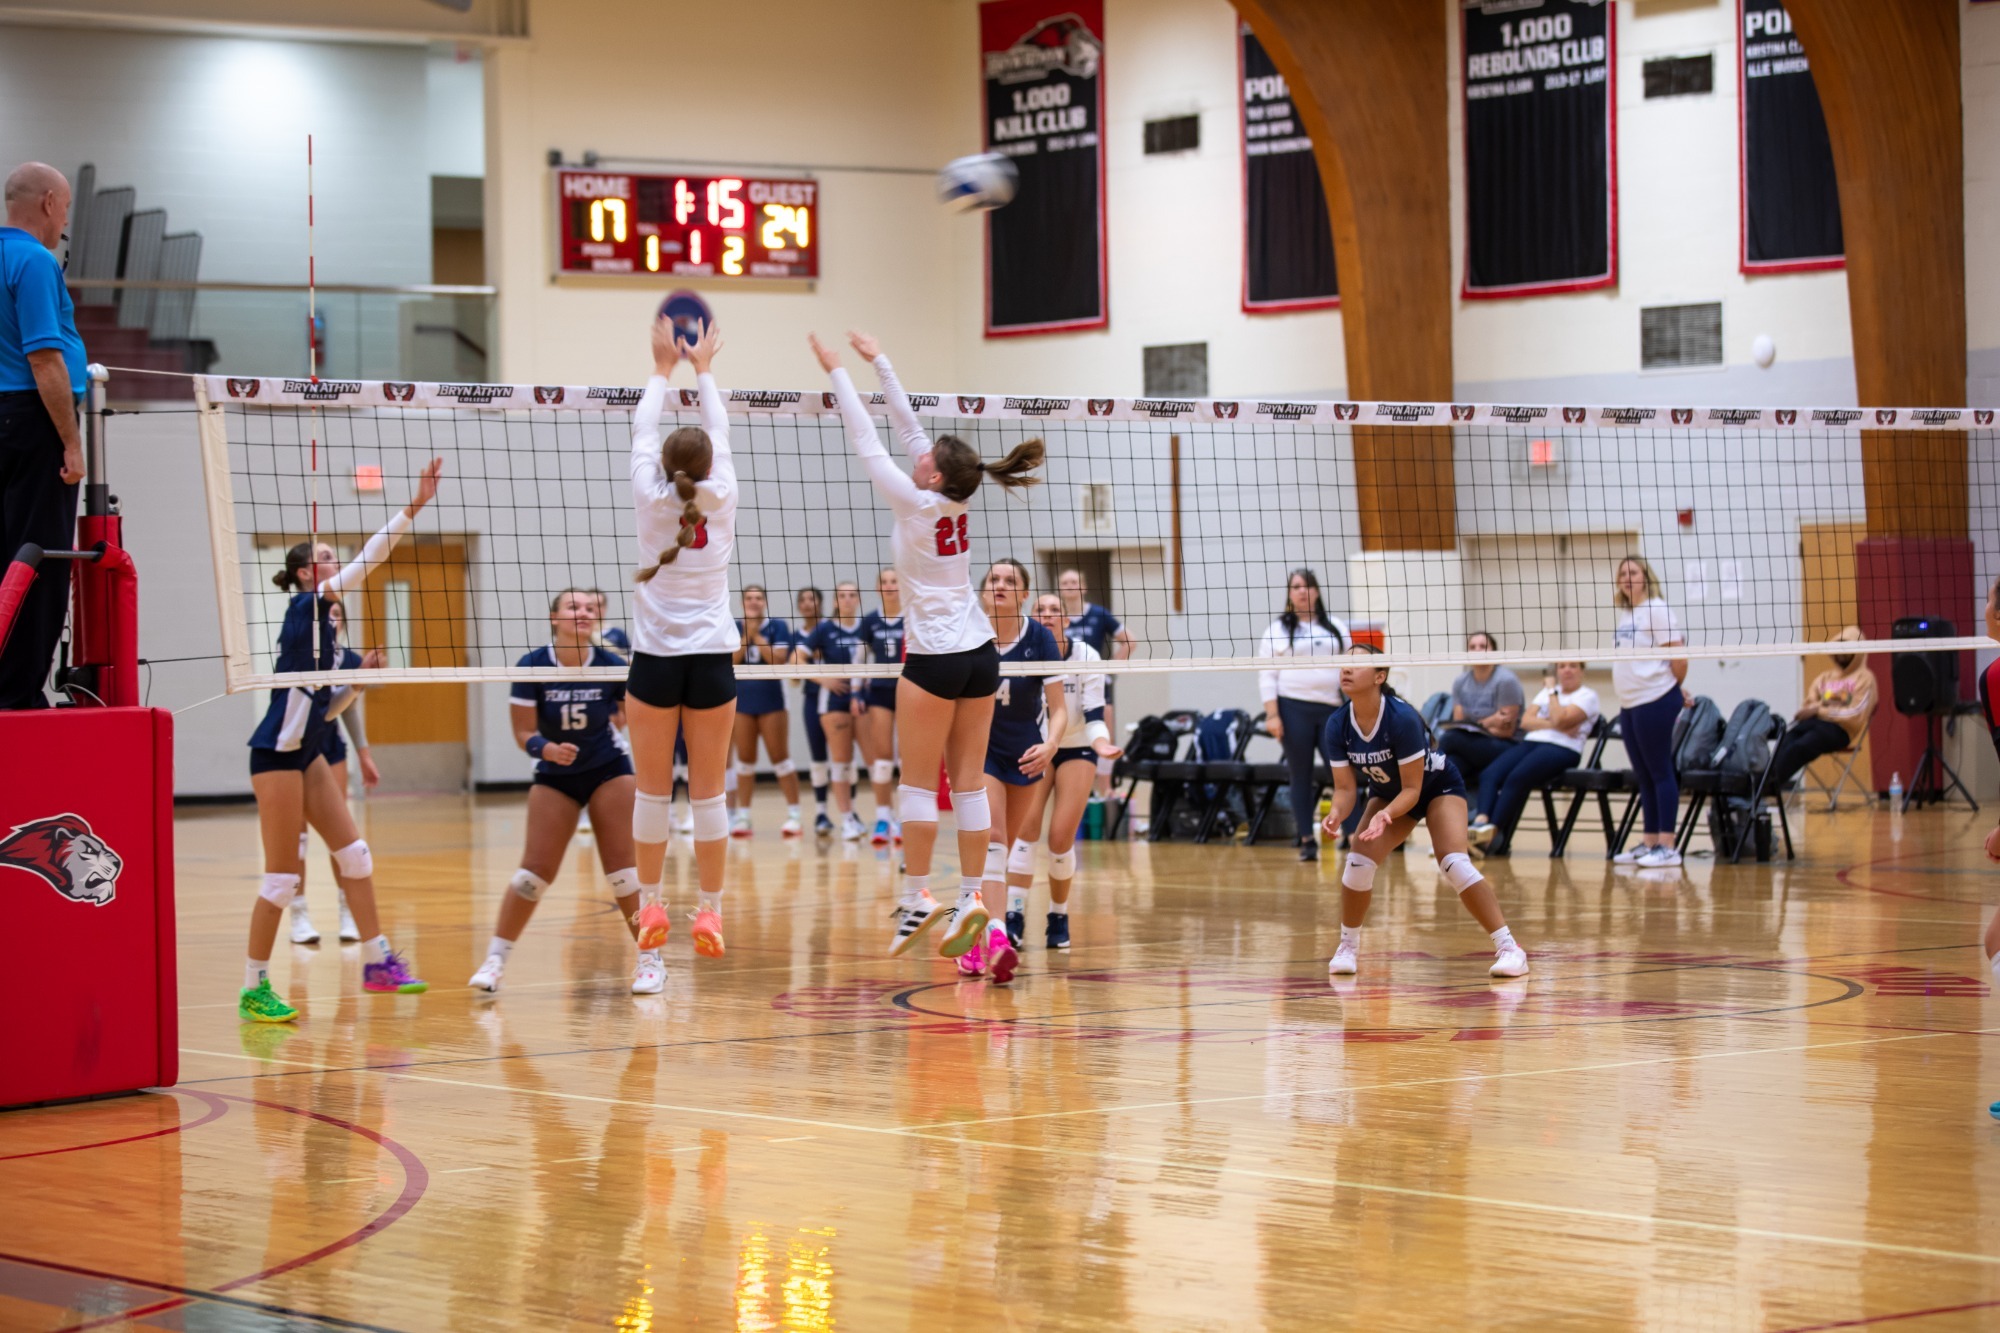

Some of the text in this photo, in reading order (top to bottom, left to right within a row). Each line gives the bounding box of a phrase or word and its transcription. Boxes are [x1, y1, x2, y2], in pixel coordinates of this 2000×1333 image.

[1501, 13, 1572, 48] 1,000
[1468, 36, 1604, 79] REBOUNDS CLUB
[1013, 83, 1071, 113] 1,000
[1036, 105, 1087, 134] CLUB
[564, 176, 630, 199] HOME
[749, 182, 815, 206] GUEST
[590, 198, 627, 242] 17
[762, 204, 808, 249] 24
[646, 234, 659, 271] 1
[690, 229, 701, 264] 1
[722, 235, 745, 274] 2
[285, 382, 361, 393] BRYN ATHYN
[439, 386, 512, 397] BRYN ATHYN
[589, 387, 644, 398] BRYN ATH
[732, 391, 799, 402] BRYN ATHYN
[1006, 398, 1069, 409] BRYN ATHYN
[1135, 401, 1195, 412] BRYN ATHYN
[1259, 403, 1317, 414] BRYN ATHYN
[1377, 405, 1434, 416] BRYN ATHYN
[1492, 407, 1547, 417] BRYN ATHYN
[561, 703, 588, 730] 15
[1368, 748, 1393, 764] STATE
